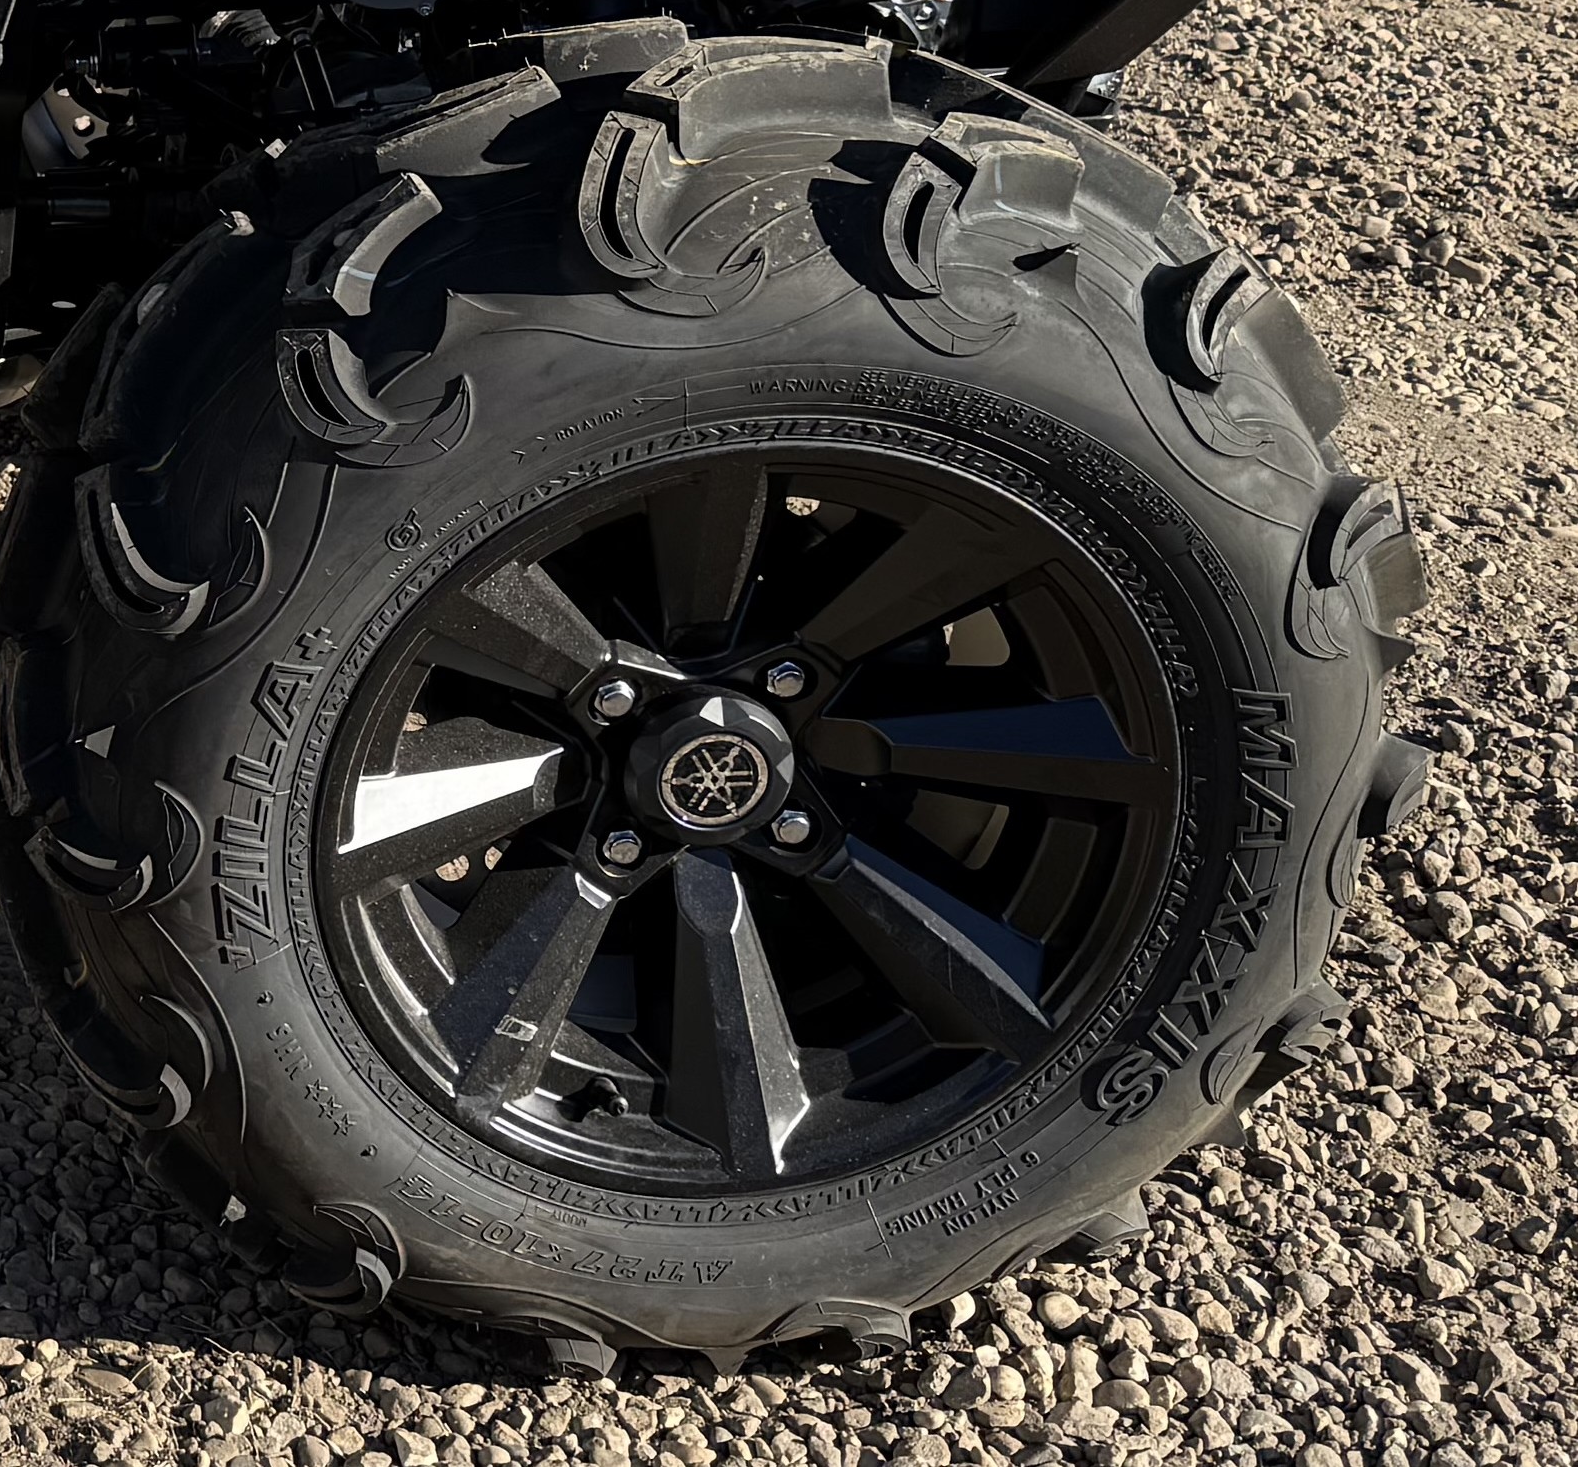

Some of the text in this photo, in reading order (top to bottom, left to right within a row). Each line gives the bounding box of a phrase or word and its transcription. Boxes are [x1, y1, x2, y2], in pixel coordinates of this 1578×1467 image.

[1095, 687, 1300, 1127] MAXXIS
[974, 1162, 1020, 1199] PLY
[883, 1190, 968, 1237] RATING
[941, 1186, 1021, 1237] NYLON
